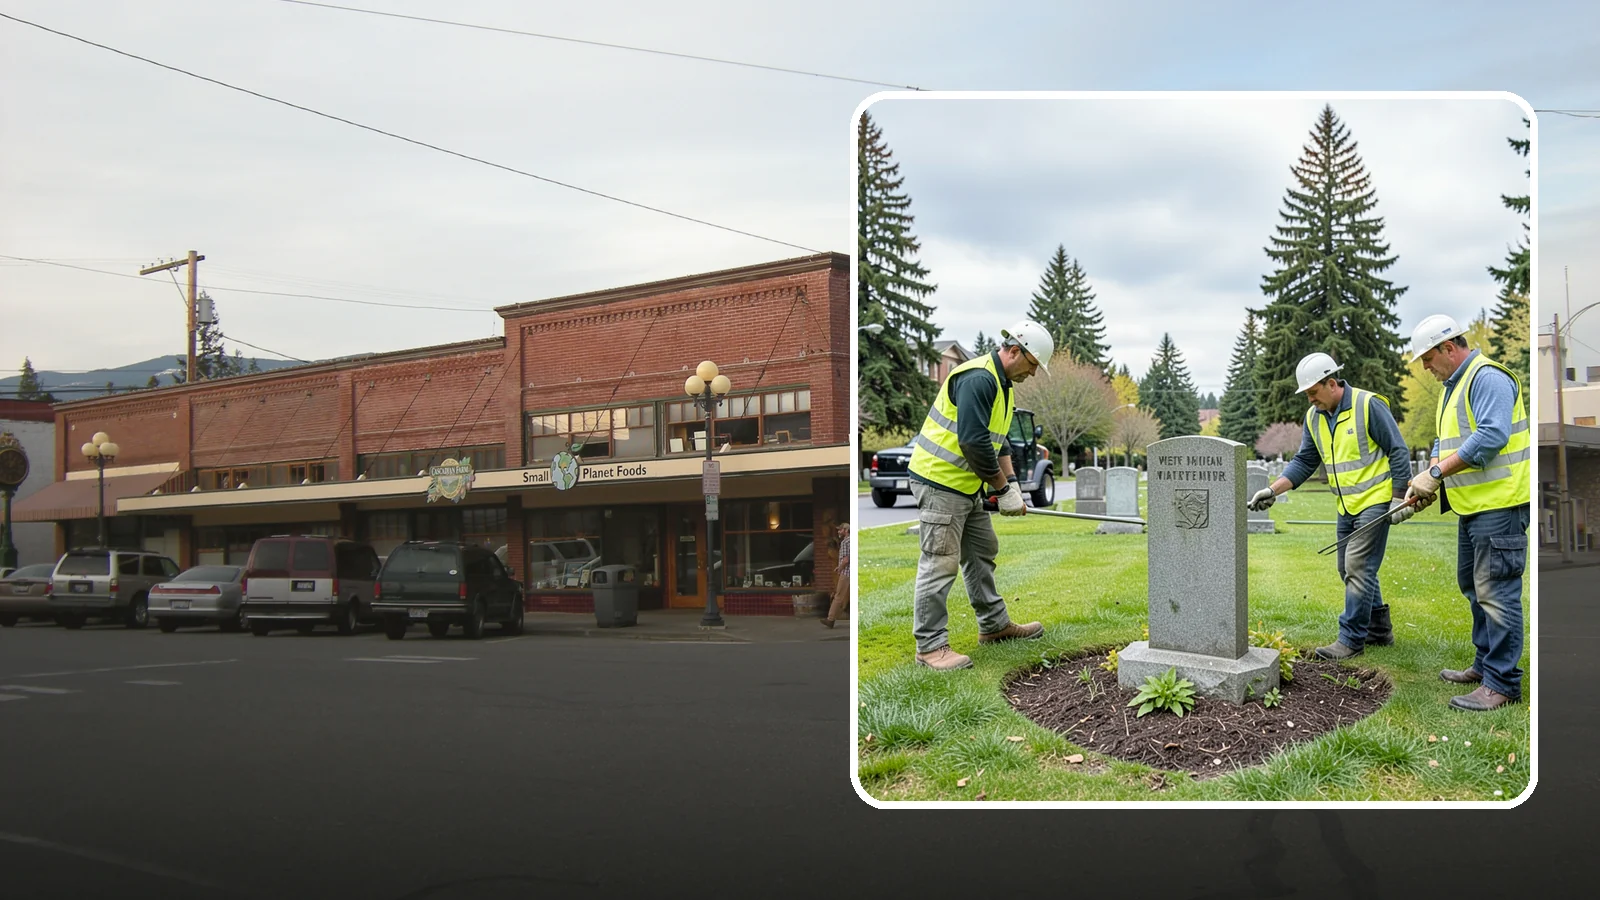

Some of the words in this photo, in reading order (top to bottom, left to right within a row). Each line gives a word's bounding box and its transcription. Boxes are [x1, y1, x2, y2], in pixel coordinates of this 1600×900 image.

[523, 470, 549, 483] Small
[582, 467, 614, 479] Planet
[616, 464, 647, 477] Foods
